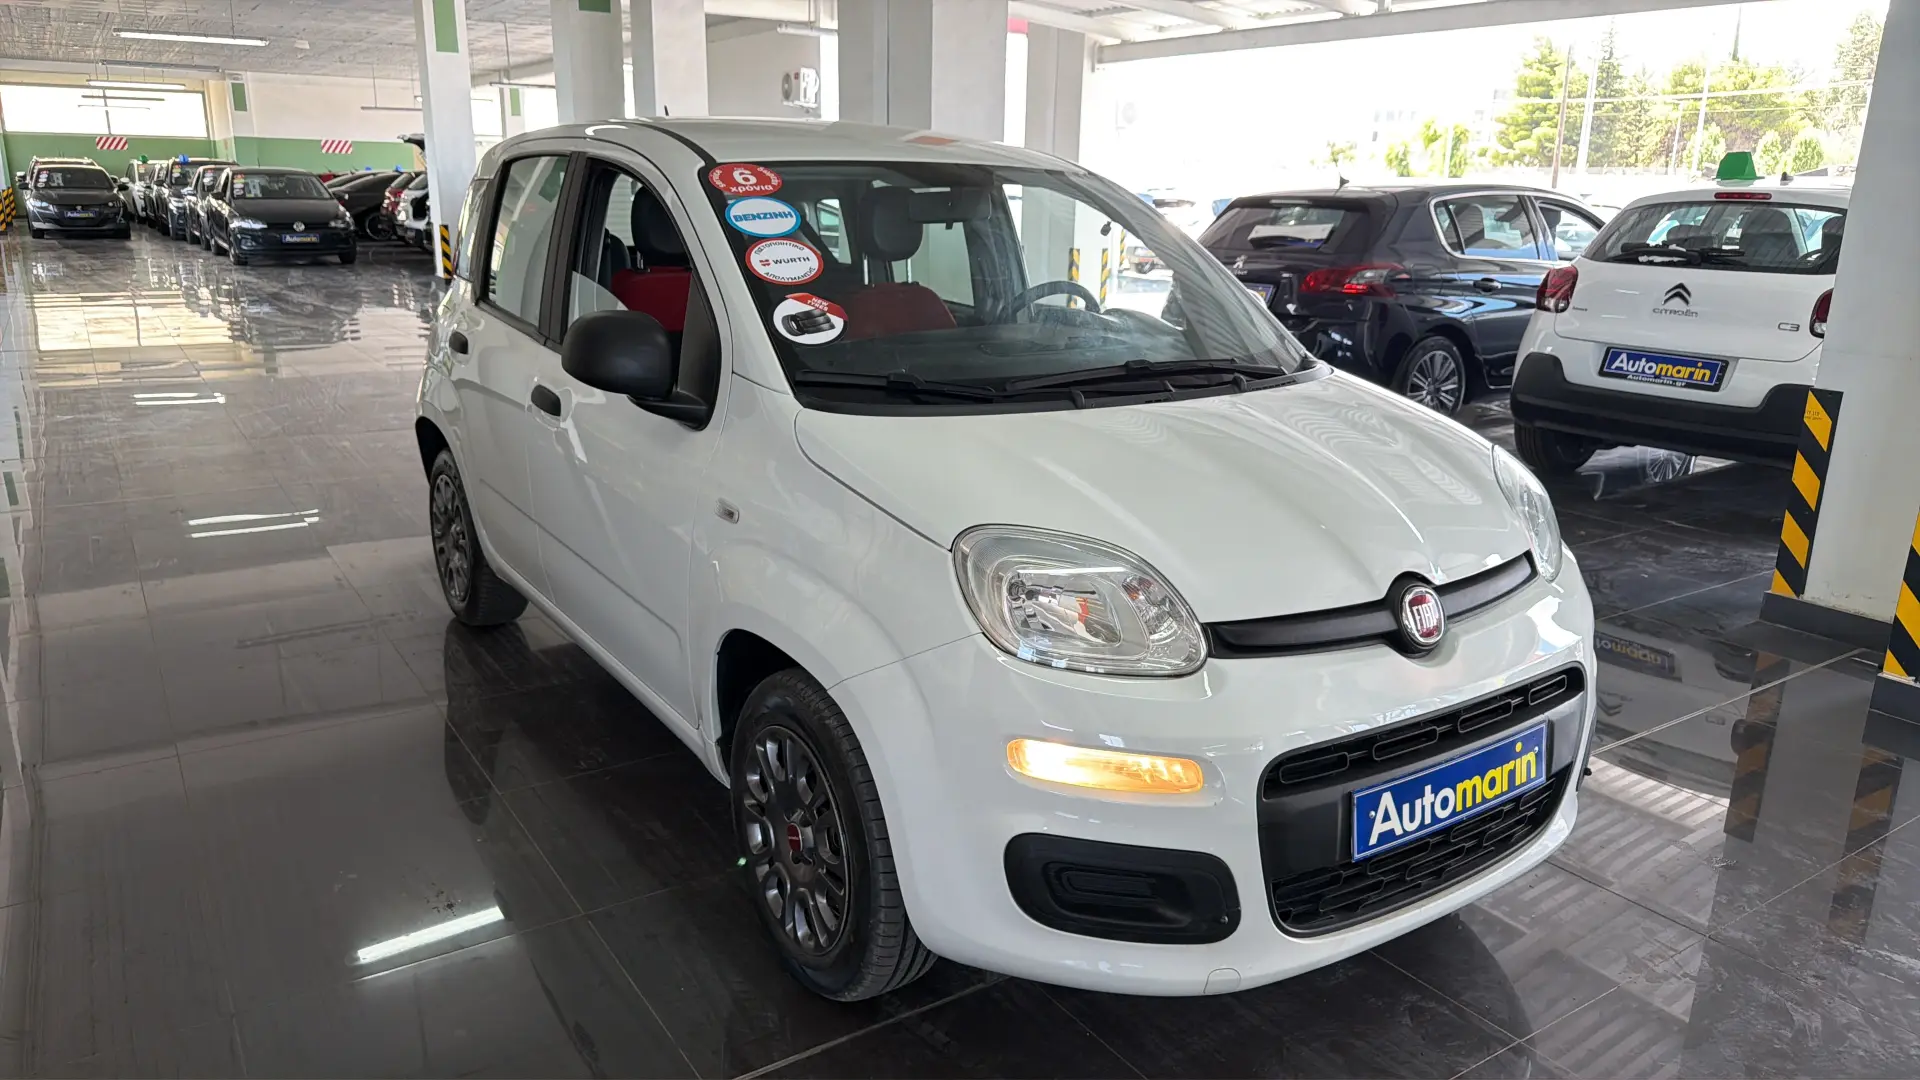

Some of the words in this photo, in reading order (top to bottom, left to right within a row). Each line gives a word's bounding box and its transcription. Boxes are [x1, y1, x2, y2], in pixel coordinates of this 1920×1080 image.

[733, 170, 757, 185] 6
[730, 185, 773, 193] χρόνια
[733, 211, 793, 222] ΒΕΝΖΙΝΗ
[1777, 322, 1800, 332] C3
[1610, 352, 1711, 382] Automarin
[1412, 603, 1438, 631] FIAT
[1368, 742, 1536, 846] Automarin
